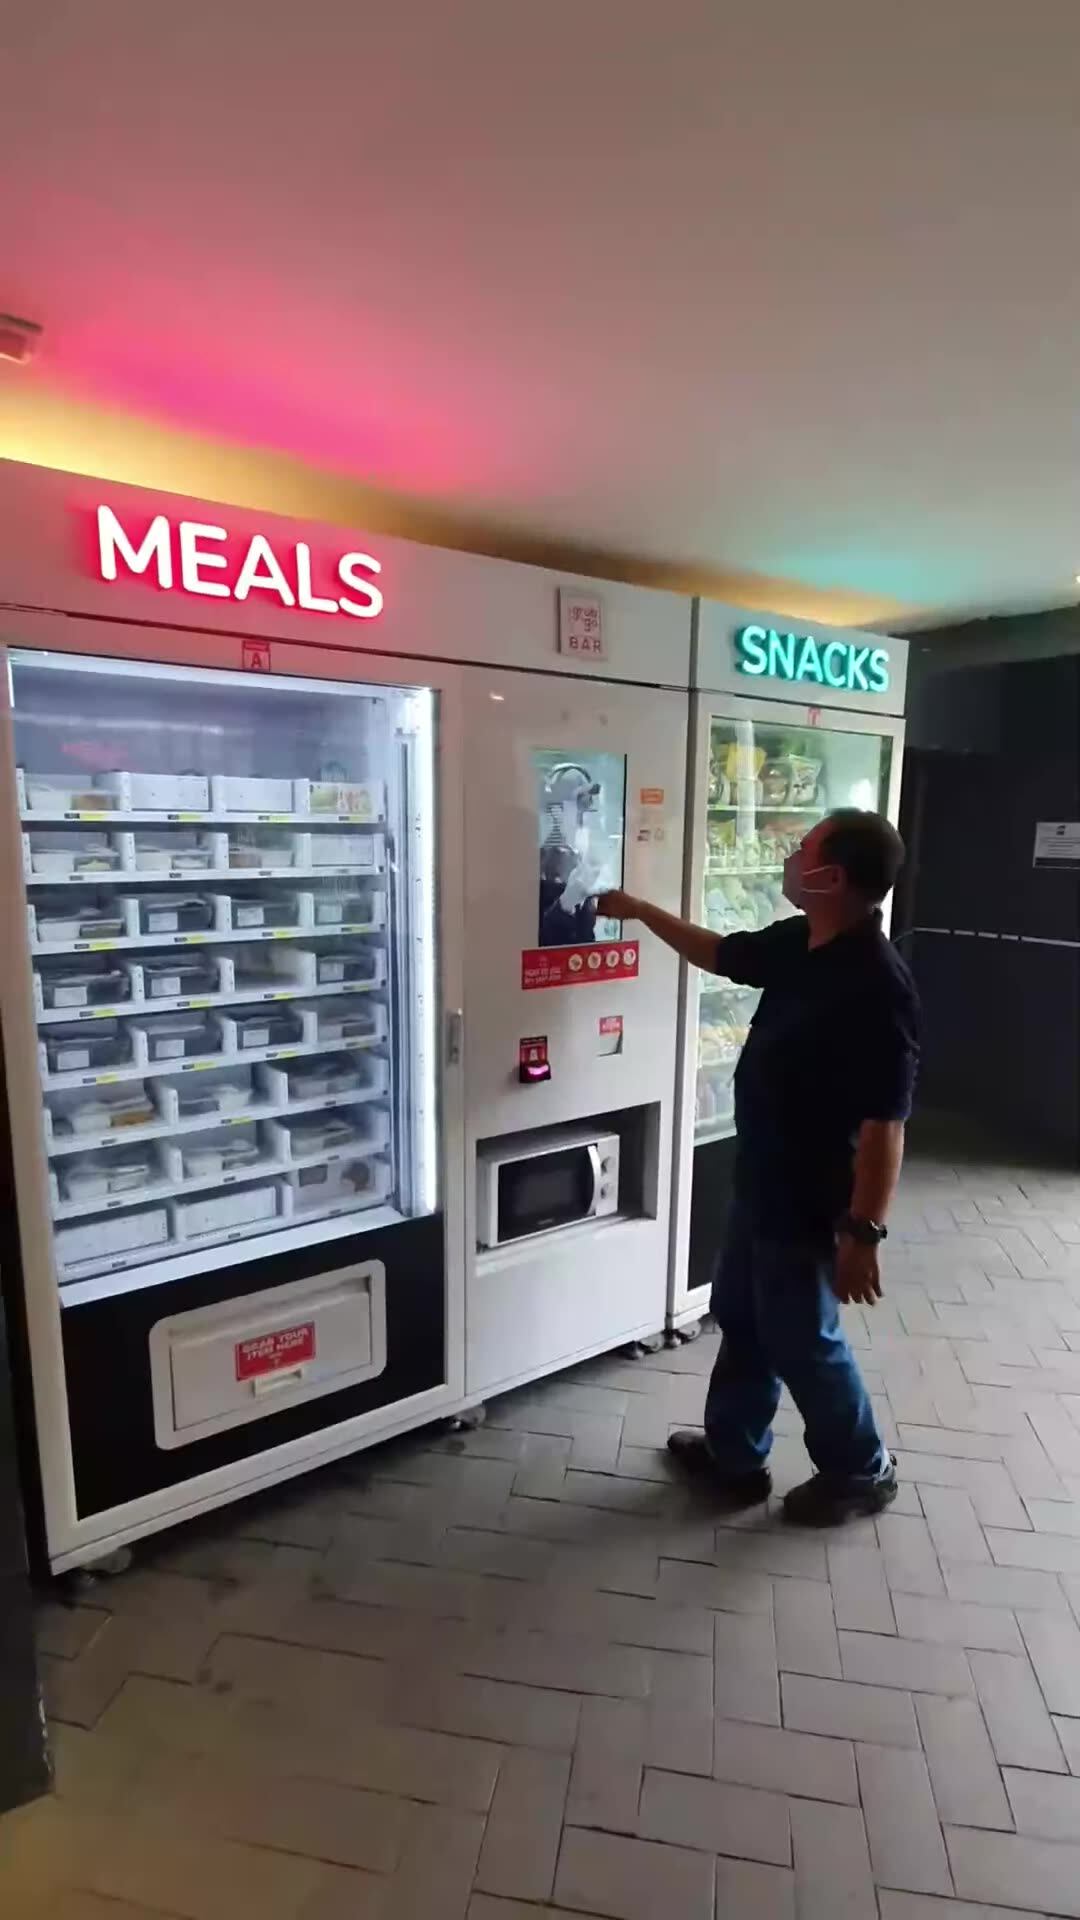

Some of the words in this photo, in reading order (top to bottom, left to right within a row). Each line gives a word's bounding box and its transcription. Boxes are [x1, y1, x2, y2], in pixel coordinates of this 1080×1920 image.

[97, 504, 384, 619] MEALS
[569, 636, 602, 653] BAR
[251, 651, 262, 668] A
[741, 624, 890, 693] SNACKS
[279, 1327, 309, 1343] YOUR
